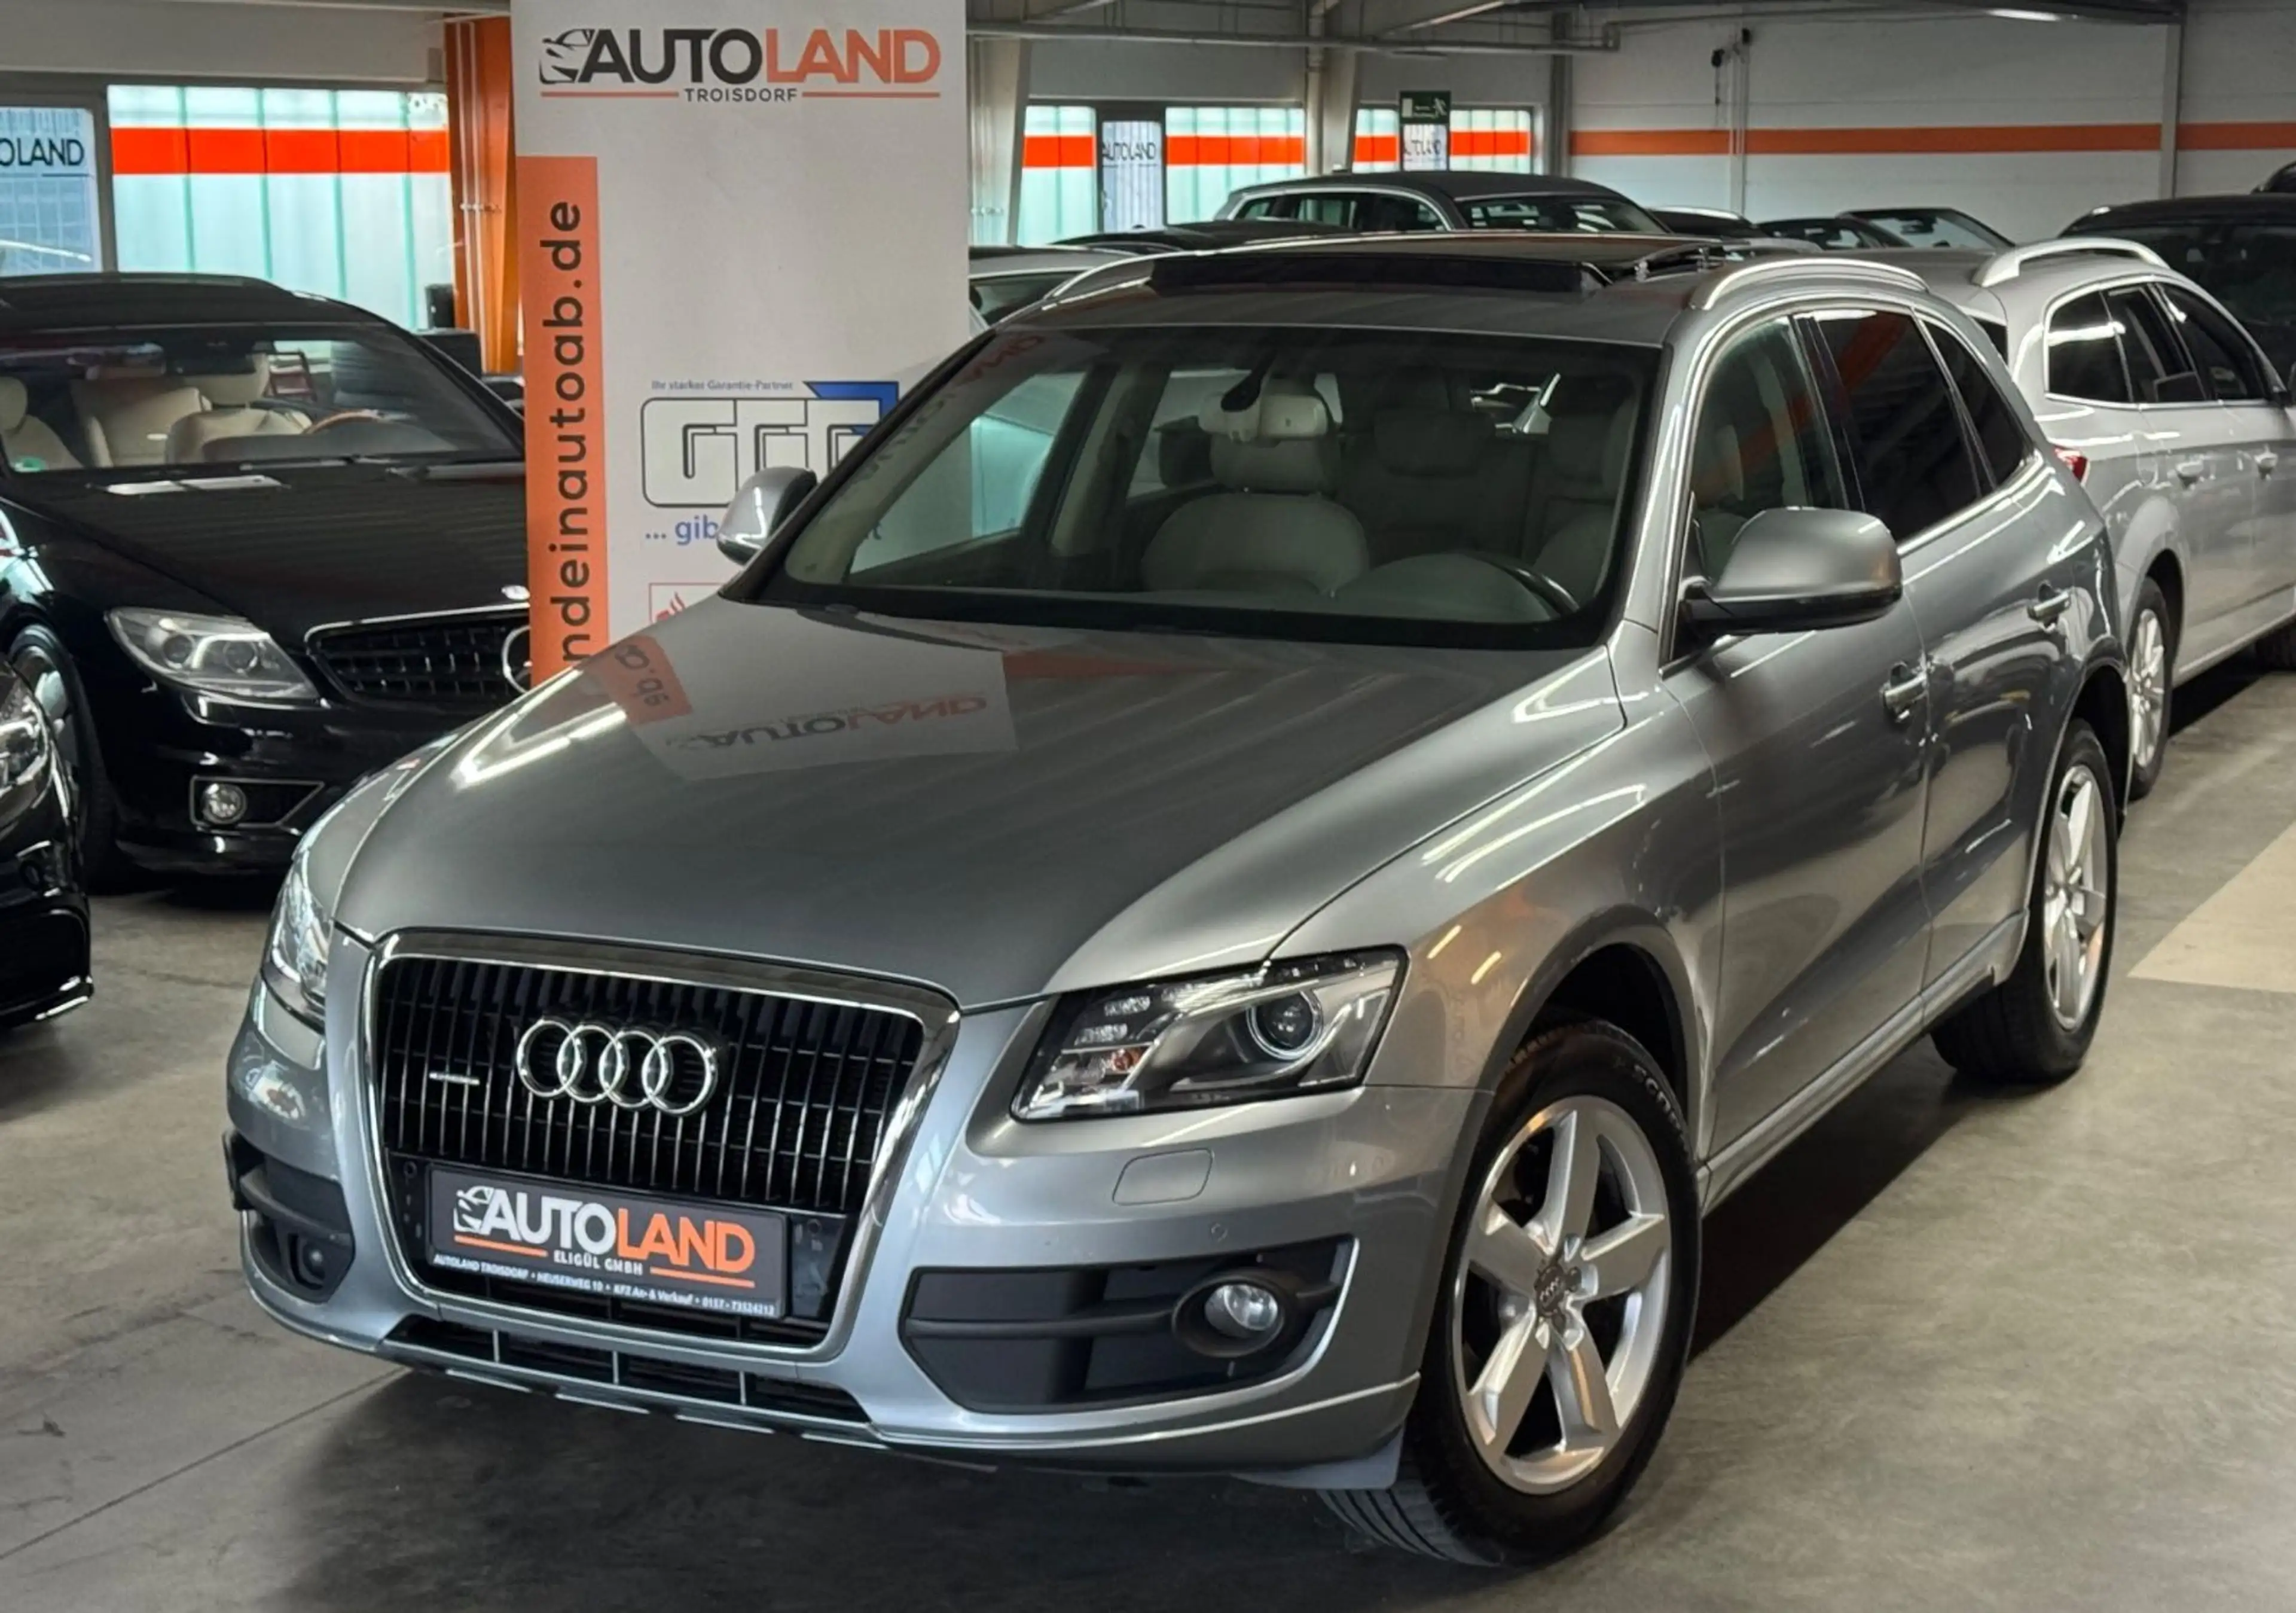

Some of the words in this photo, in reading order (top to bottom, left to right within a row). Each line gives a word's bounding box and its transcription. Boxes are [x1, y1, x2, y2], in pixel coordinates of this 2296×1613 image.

[578, 28, 941, 84] AUTOLAND
[684, 88, 798, 102] TROISDORF
[539, 201, 591, 662] ndeinautoab.de
[480, 1188, 755, 1273] AUTOLAND
[433, 1254, 479, 1272] AUTOLAND
[481, 1261, 529, 1279] TROISDORF
[553, 1249, 600, 1269] ELIGÜL
